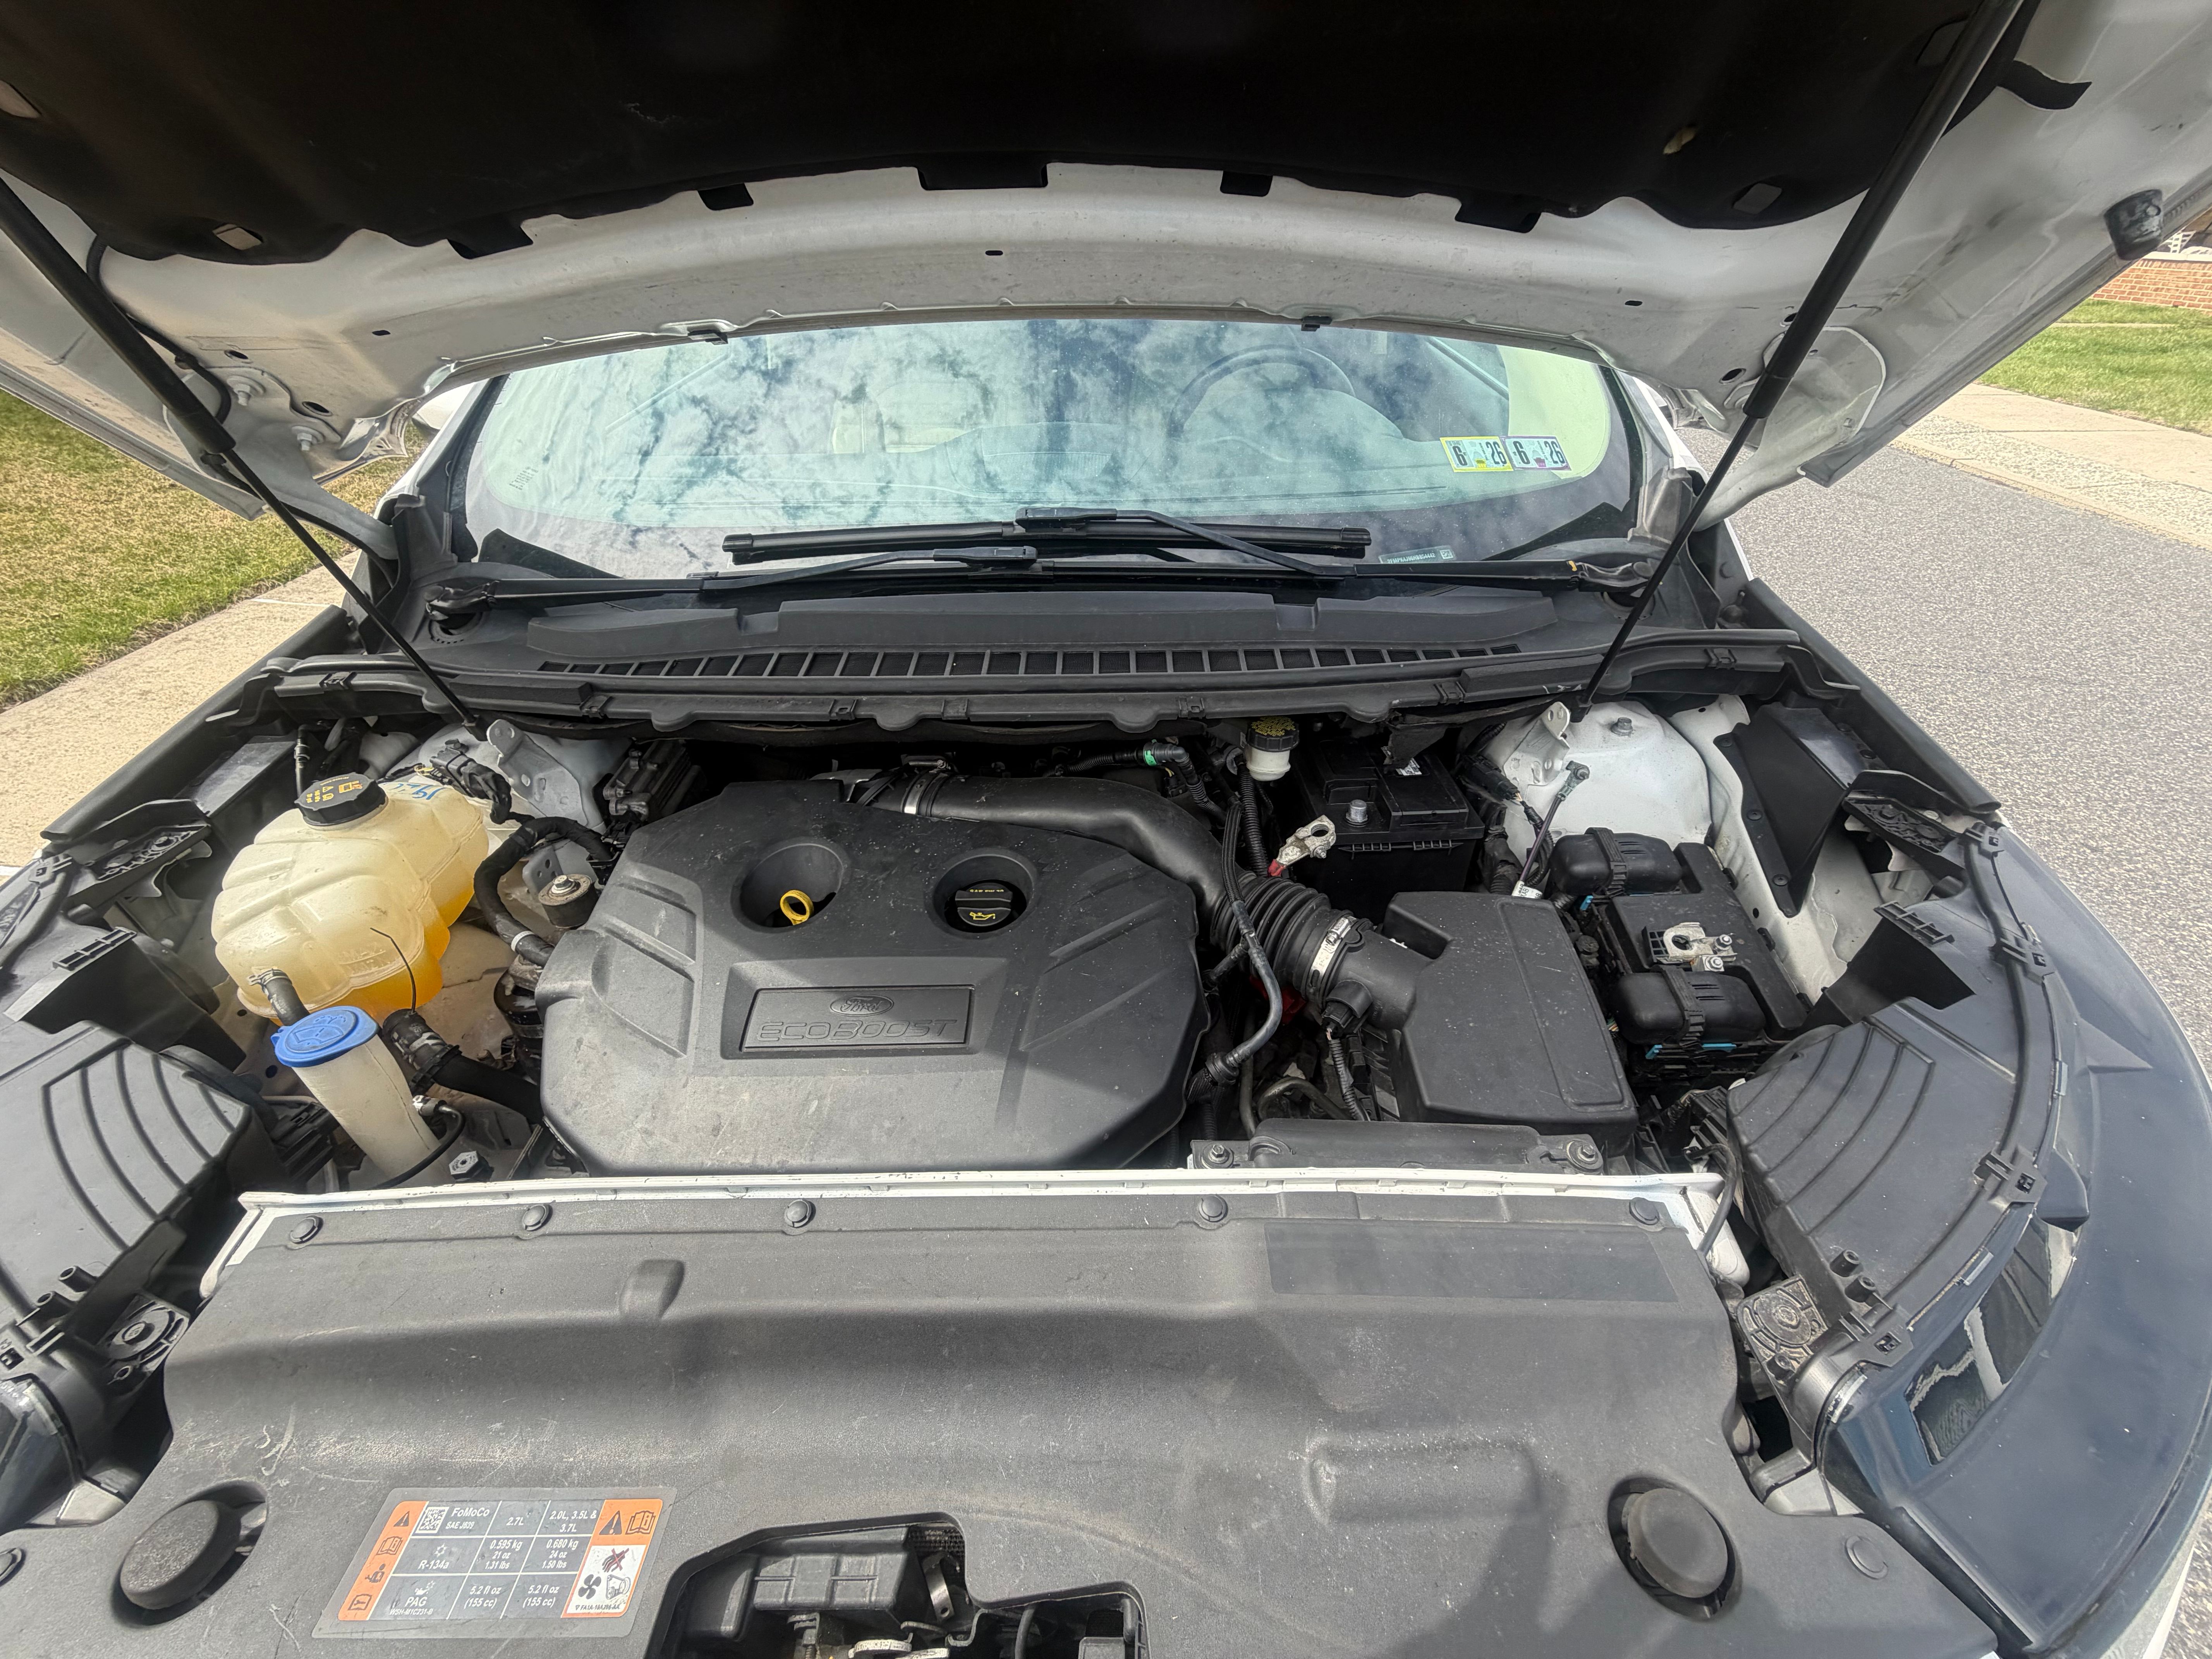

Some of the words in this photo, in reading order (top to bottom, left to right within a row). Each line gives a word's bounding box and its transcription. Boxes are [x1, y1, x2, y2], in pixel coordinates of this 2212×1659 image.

[1452, 445, 1468, 466] 6
[1486, 441, 1507, 465] 26
[1513, 441, 1530, 464] 6
[1544, 441, 1566, 464] 26
[840, 996, 883, 1012] Ford
[757, 1019, 957, 1042] ECOBOOST
[451, 1507, 490, 1517] FoMoCo
[549, 1510, 569, 1520] 2.0L,
[571, 1510, 588, 1519] 3.5L
[590, 1510, 597, 1519] &
[506, 1516, 524, 1526] 2.7L
[559, 1523, 577, 1532] 3.7L
[489, 1539, 511, 1549] 0.595
[511, 1539, 523, 1551] kg
[546, 1539, 568, 1549] 0.680
[568, 1539, 579, 1551] kg
[492, 1551, 502, 1559] 21
[549, 1550, 558, 1558] 24
[418, 1559, 450, 1570] R-134a
[485, 1561, 500, 1569] 1.31
[499, 1561, 510, 1569] lbs
[542, 1560, 556, 1568] 1.50
[556, 1560, 567, 1568] lbs
[469, 1585, 484, 1594] 5.2
[484, 1585, 491, 1595] fl
[528, 1585, 542, 1594] 5.2
[541, 1585, 549, 1594] fl
[404, 1596, 428, 1607] PAG
[464, 1597, 484, 1609] (155
[484, 1597, 497, 1609] cc)
[523, 1597, 542, 1608] (155
[542, 1597, 556, 1608] cc)
